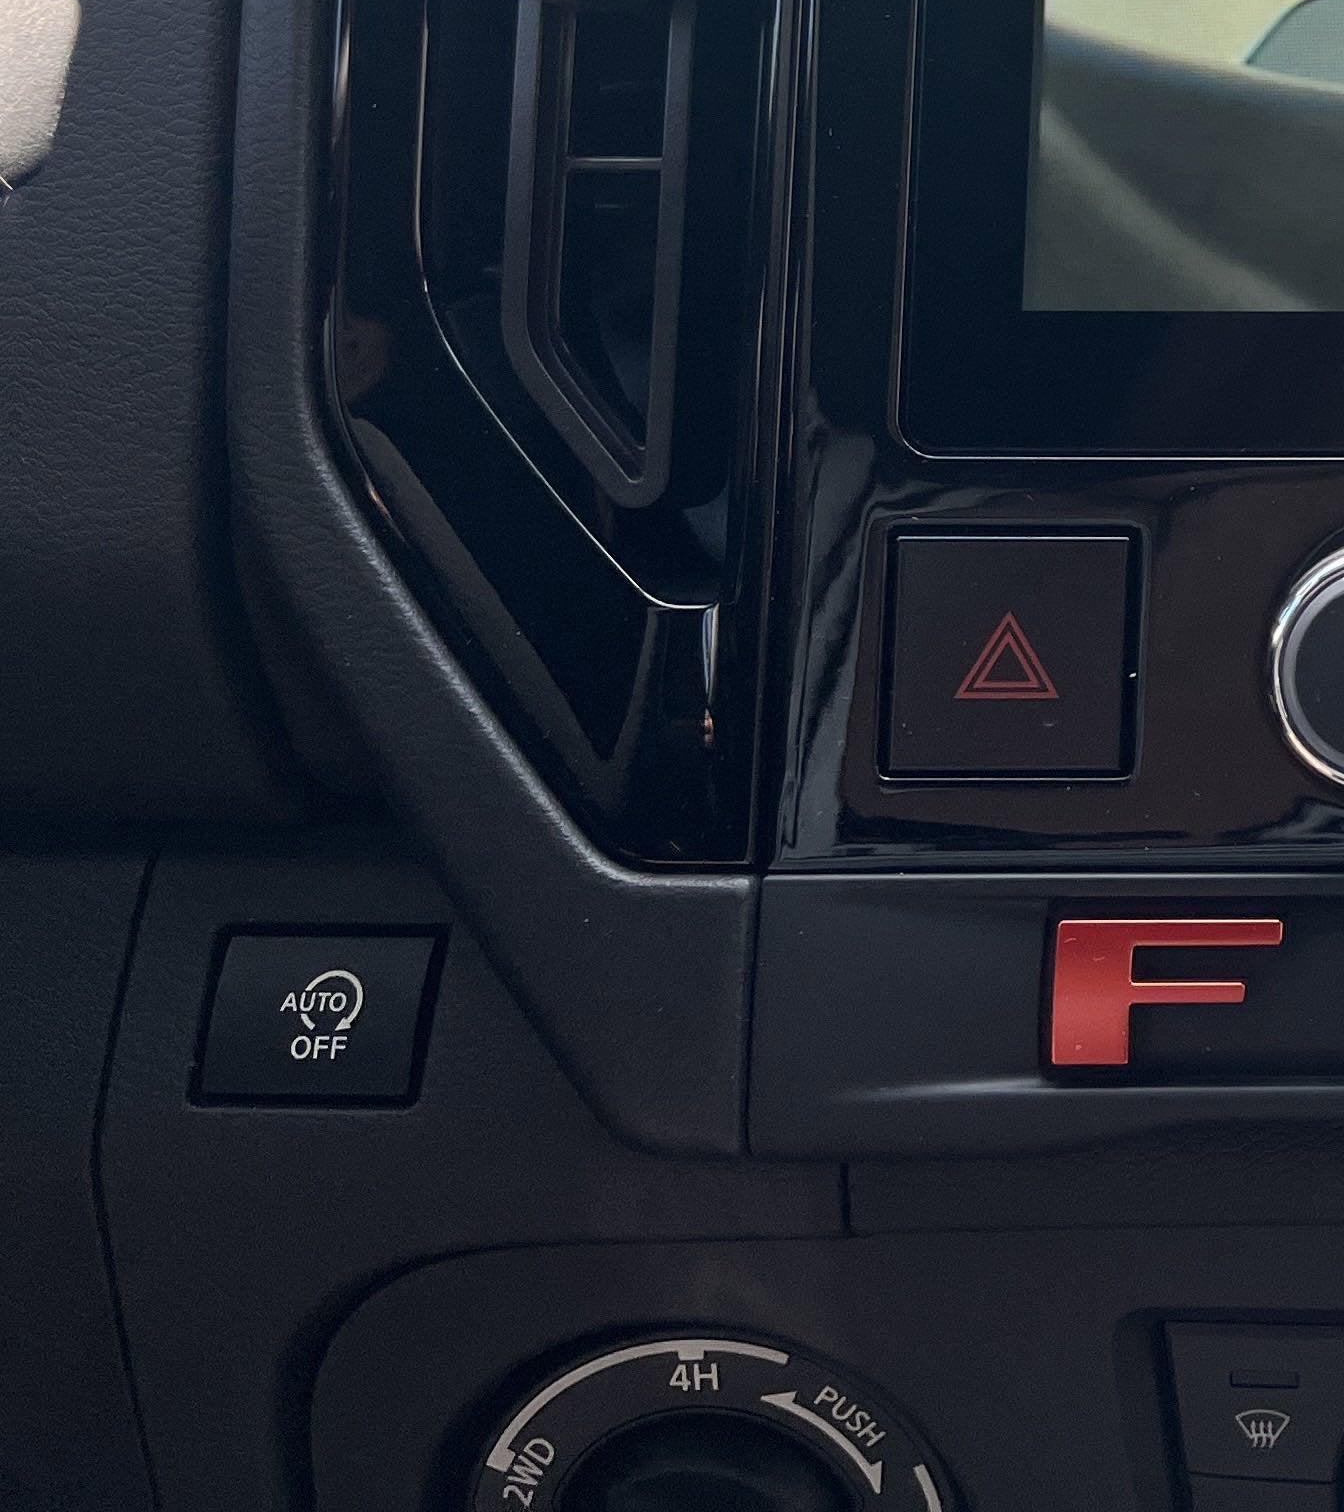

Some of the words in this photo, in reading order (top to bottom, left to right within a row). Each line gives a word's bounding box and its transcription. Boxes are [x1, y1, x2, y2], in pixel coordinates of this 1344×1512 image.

[280, 991, 348, 1013] AUTO
[290, 1035, 348, 1061] OFF
[669, 1362, 720, 1392] 4H
[813, 1385, 887, 1448] PUSH
[503, 1436, 556, 1507] 2WD
